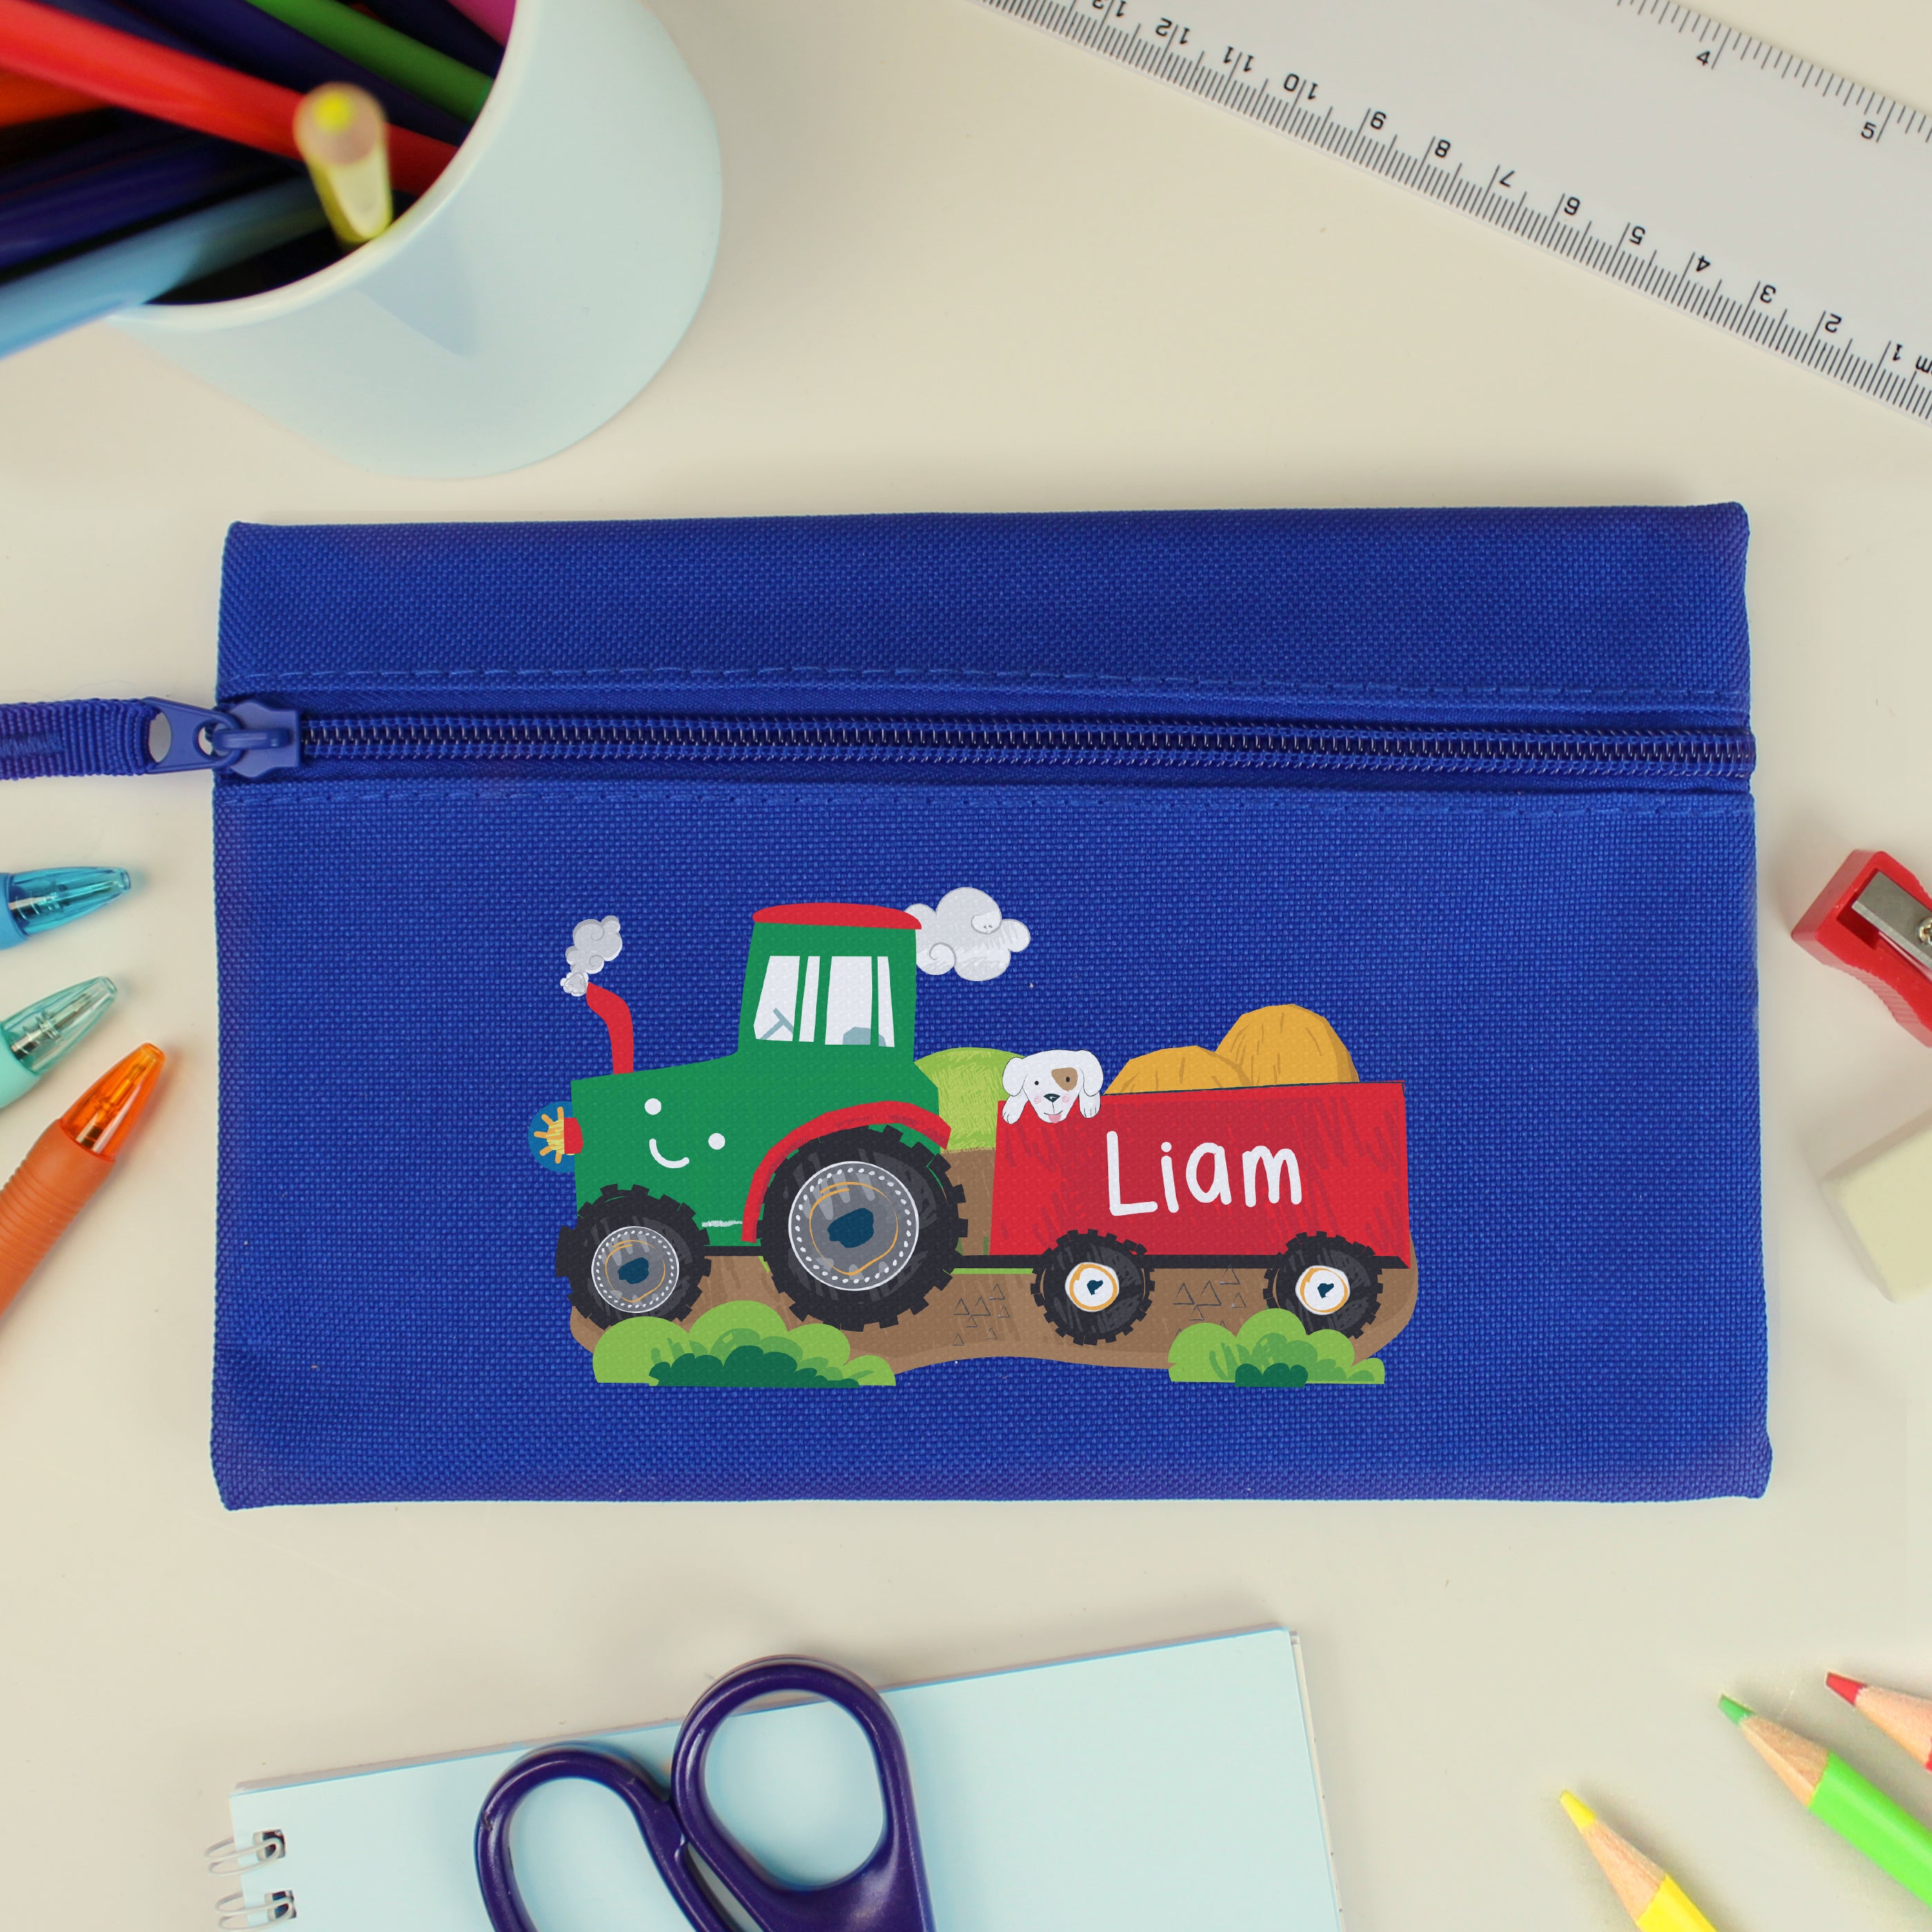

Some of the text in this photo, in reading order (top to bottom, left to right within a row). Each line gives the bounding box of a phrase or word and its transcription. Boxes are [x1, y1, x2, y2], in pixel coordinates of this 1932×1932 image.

[1155, 17, 1190, 45] 12
[1223, 46, 1254, 72] 11
[1283, 73, 1318, 100] 10
[1696, 51, 1876, 139] 4 5
[1370, 111, 1387, 130] 9
[1435, 139, 1451, 158] 8
[1499, 170, 1515, 188] 7
[1564, 197, 1580, 216] 6
[1629, 226, 1646, 246] 5
[1695, 255, 1711, 272] 4
[1759, 284, 1776, 304] 3
[1824, 313, 1842, 333] 2
[1892, 344, 1902, 362] 1
[1106, 1130, 1302, 1216] Liam
